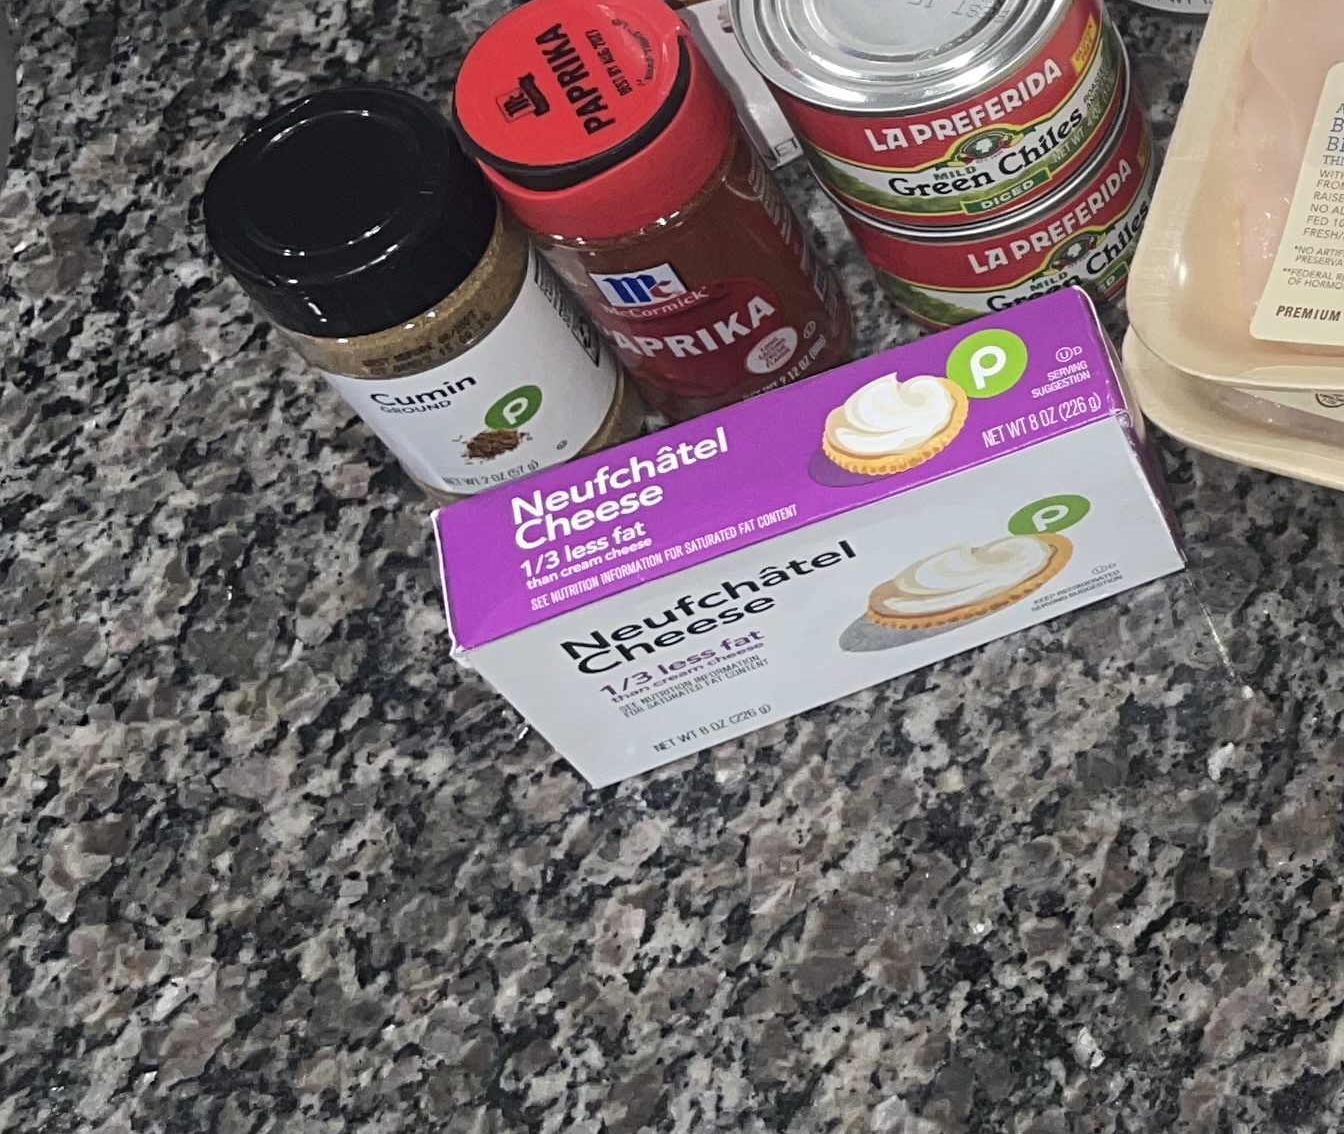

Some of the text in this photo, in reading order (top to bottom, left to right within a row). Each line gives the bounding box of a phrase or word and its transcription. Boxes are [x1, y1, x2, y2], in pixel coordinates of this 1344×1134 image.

[535, 22, 615, 136] PAPRIKA
[864, 128, 907, 152] LA
[914, 57, 1062, 146] PREFERIDA
[889, 105, 1083, 198] Green Chiles
[933, 165, 977, 181] MILD
[967, 158, 1132, 275] LA PREFERIDA
[980, 177, 1035, 210] DICED
[602, 295, 776, 359] APRIKA
[1275, 305, 1341, 321] PREMIUM
[370, 375, 477, 406] Cumin
[1031, 371, 1090, 398] SUGGESTION
[1047, 361, 1088, 380] SERVING
[380, 400, 452, 414] GROUND
[983, 392, 1102, 448] NET WT 8 OZ (226 g)
[511, 426, 728, 526] Neufchâtel
[514, 484, 664, 550] Cheese
[519, 522, 646, 579] 1/3 less fat
[526, 537, 652, 590] than cream cheese
[531, 504, 798, 611] SEE NUTRITION INFORMATION FOR SATURATED FAT CONTENT
[561, 539, 856, 660] Neufchâtel
[578, 595, 776, 675] Cheese
[599, 630, 765, 697] 1/3 less fat
